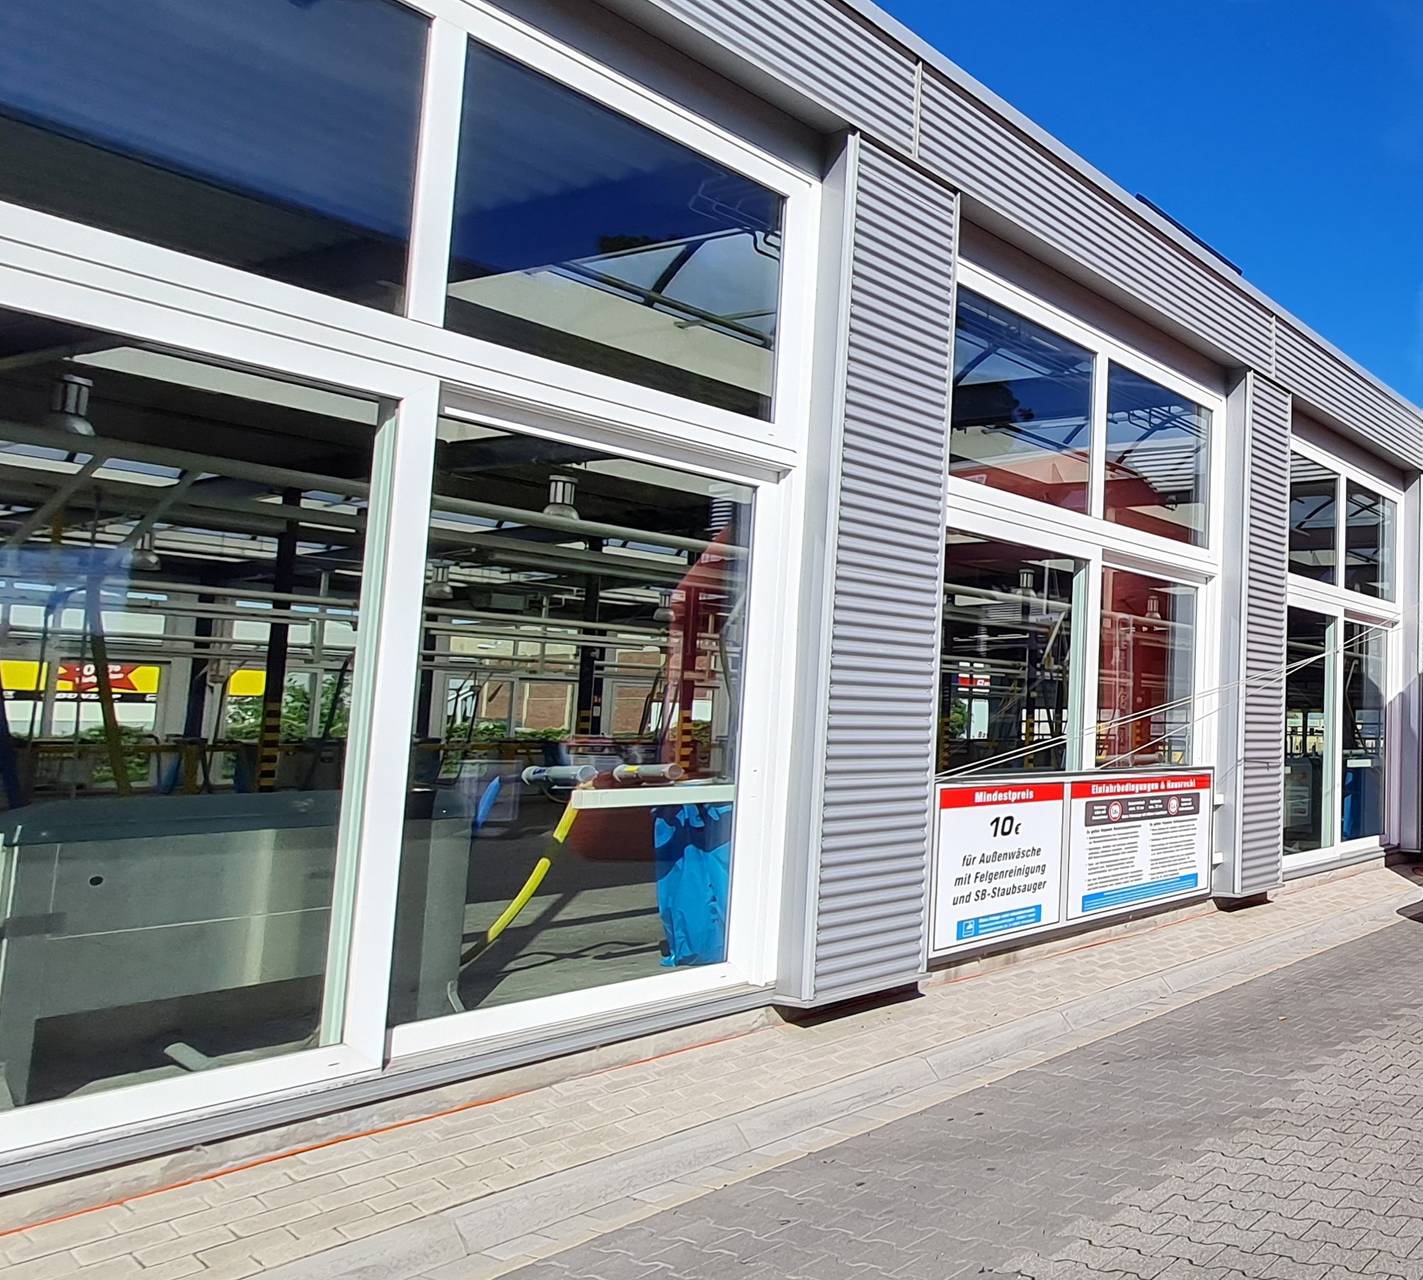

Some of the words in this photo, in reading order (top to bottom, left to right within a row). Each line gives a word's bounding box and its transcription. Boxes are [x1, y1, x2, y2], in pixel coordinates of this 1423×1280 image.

[974, 788, 1034, 803] Mindestpreis
[1091, 781, 1159, 795] Einfahrbedingungen
[961, 854, 977, 867] für
[978, 846, 1042, 865] Außenwäsche
[954, 873, 971, 887] mit
[973, 863, 1047, 884] Felgenreinigung
[952, 891, 972, 906] und
[974, 880, 1047, 902] SB-Staubsauger
